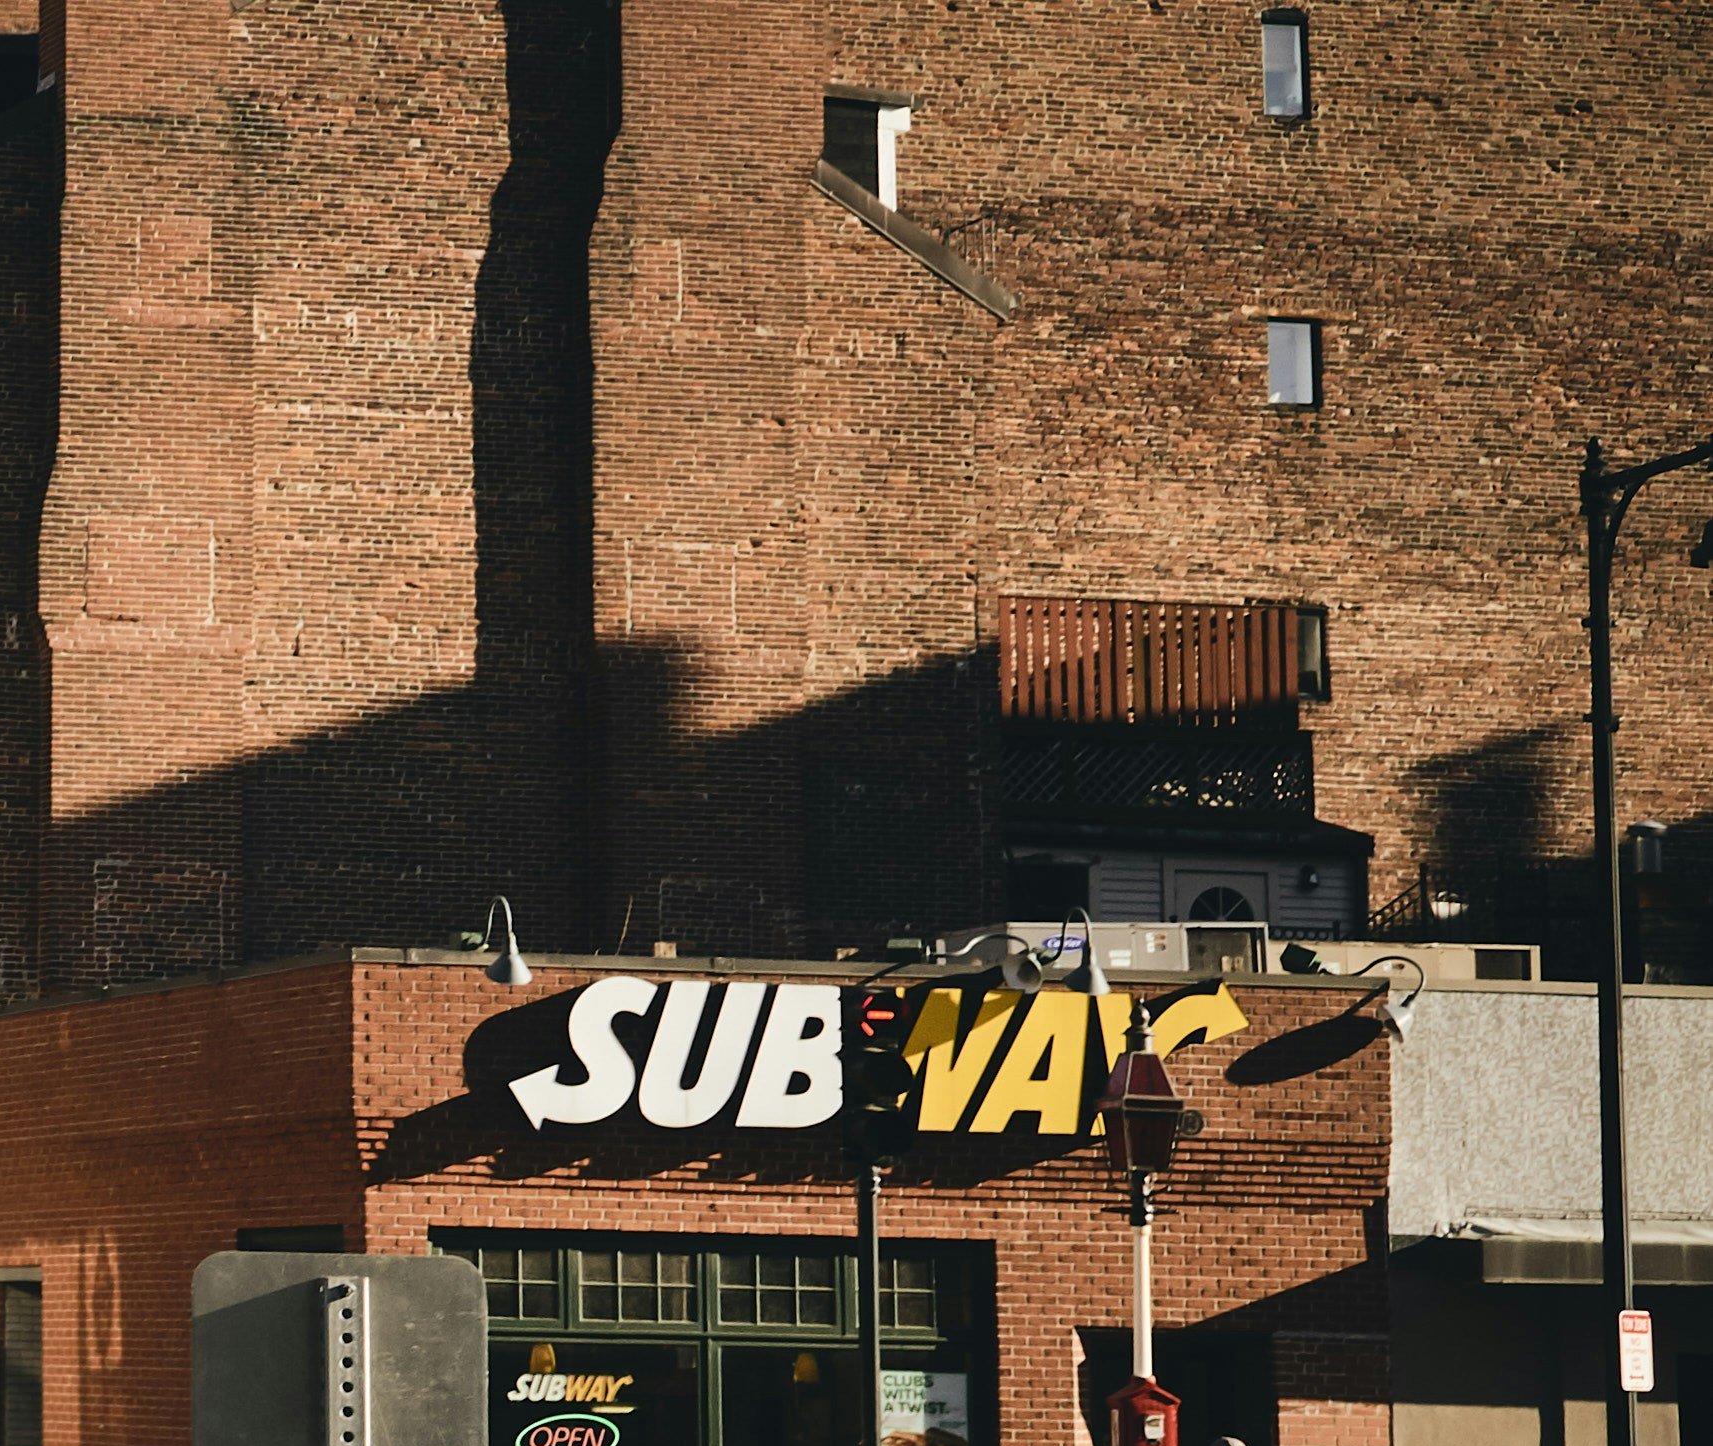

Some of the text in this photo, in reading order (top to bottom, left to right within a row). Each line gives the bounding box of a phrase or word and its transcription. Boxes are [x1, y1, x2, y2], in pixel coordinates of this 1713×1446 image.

[507, 1373, 634, 1402] SUBWAY
[883, 1374, 934, 1388] CLUBS
[883, 1387, 924, 1400] WITH
[884, 1401, 950, 1415] A TWIST.
